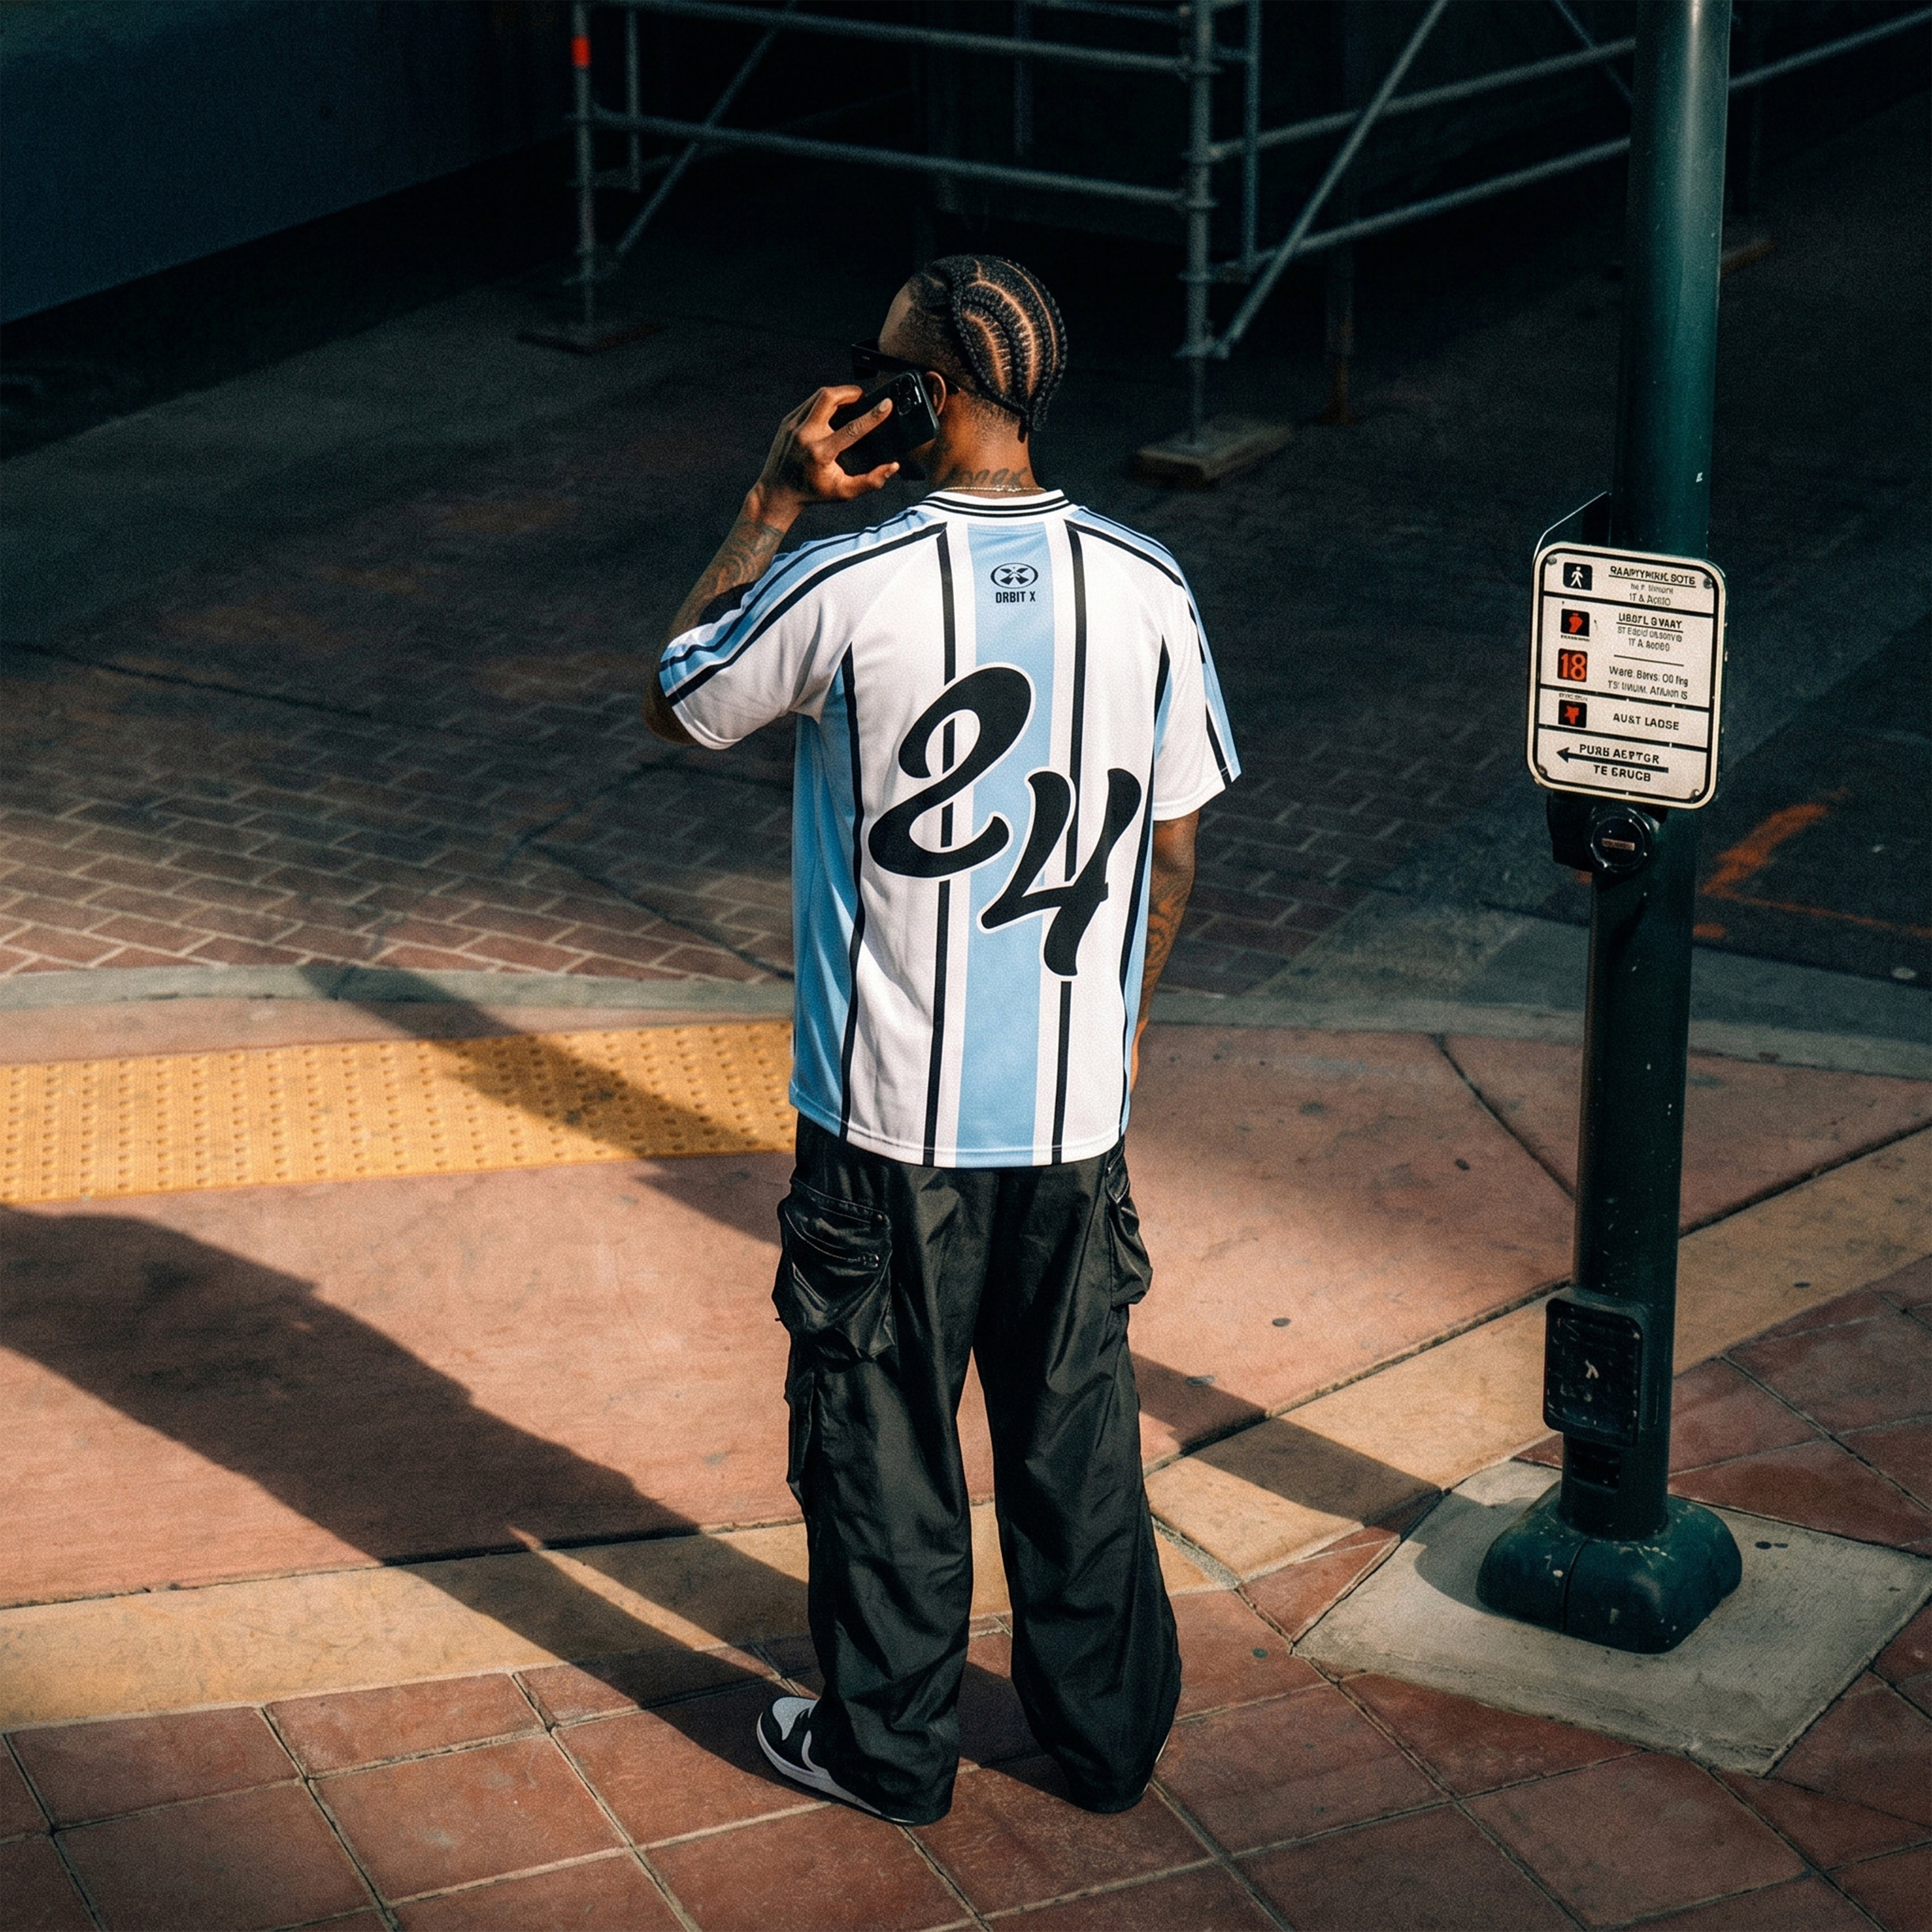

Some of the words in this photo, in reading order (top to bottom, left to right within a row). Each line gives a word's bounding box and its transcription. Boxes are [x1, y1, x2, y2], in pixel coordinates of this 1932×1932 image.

[996, 591, 1026, 603] ORBIT
[1029, 591, 1036, 602] X
[1561, 653, 1586, 681] 18
[867, 666, 1142, 977] 24
